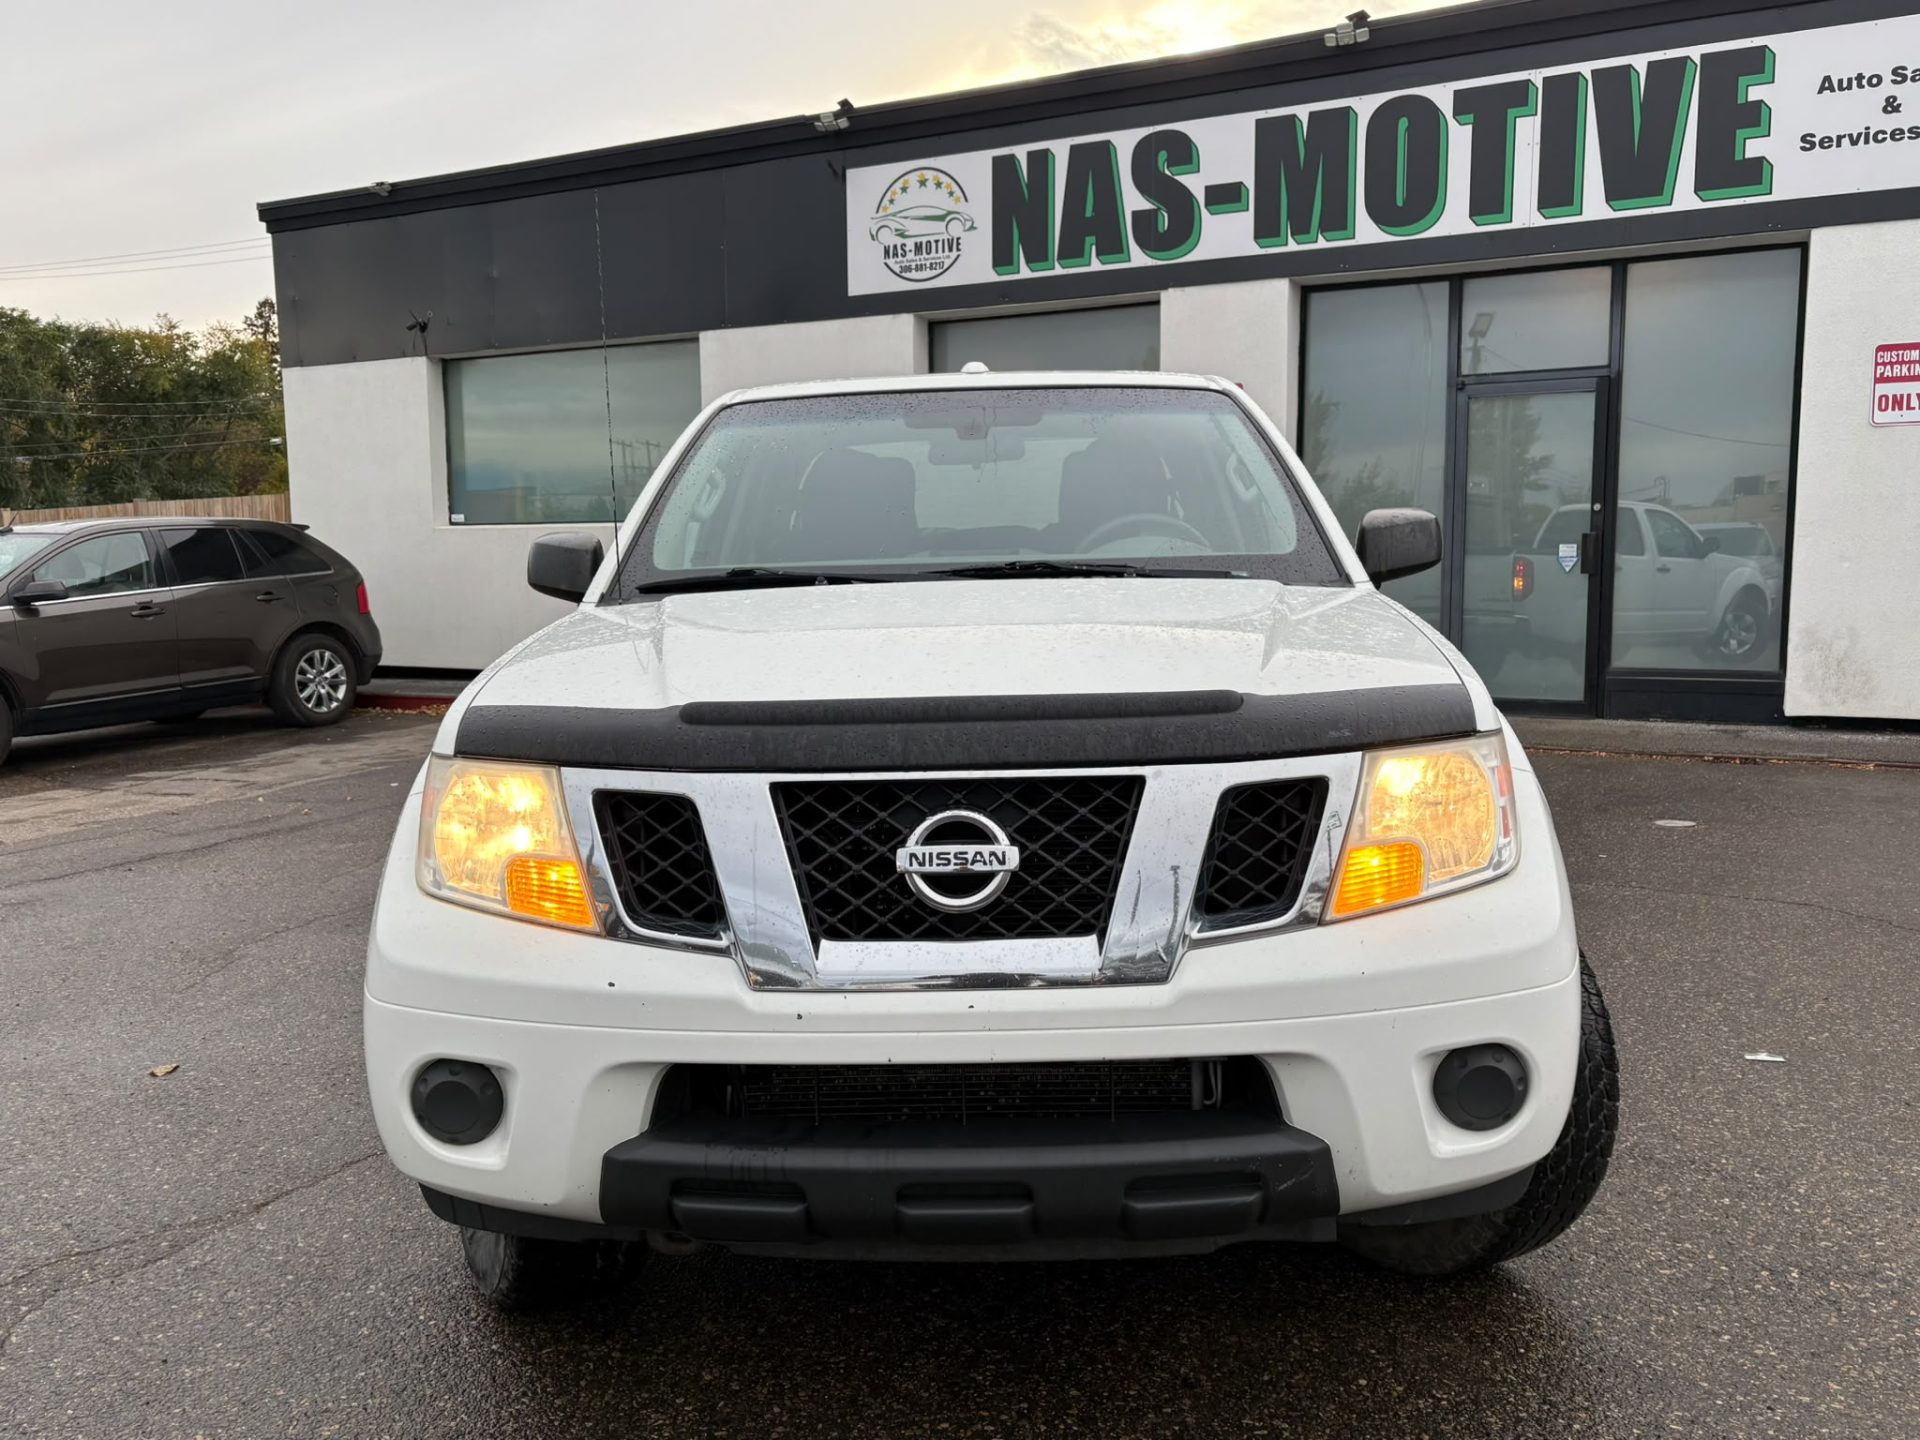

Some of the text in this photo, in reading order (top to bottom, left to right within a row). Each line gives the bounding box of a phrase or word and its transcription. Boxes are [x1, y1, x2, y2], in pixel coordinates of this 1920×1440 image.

[1817, 72, 1883, 95] Auto
[1881, 95, 1902, 114] &
[1799, 126, 1920, 152] Services
[991, 44, 1776, 277] NAS-MOTIVE
[883, 237, 962, 260] NAS-MOTIVE
[1877, 349, 1920, 363] CUSTOM
[909, 851, 1006, 867] NISSAN
